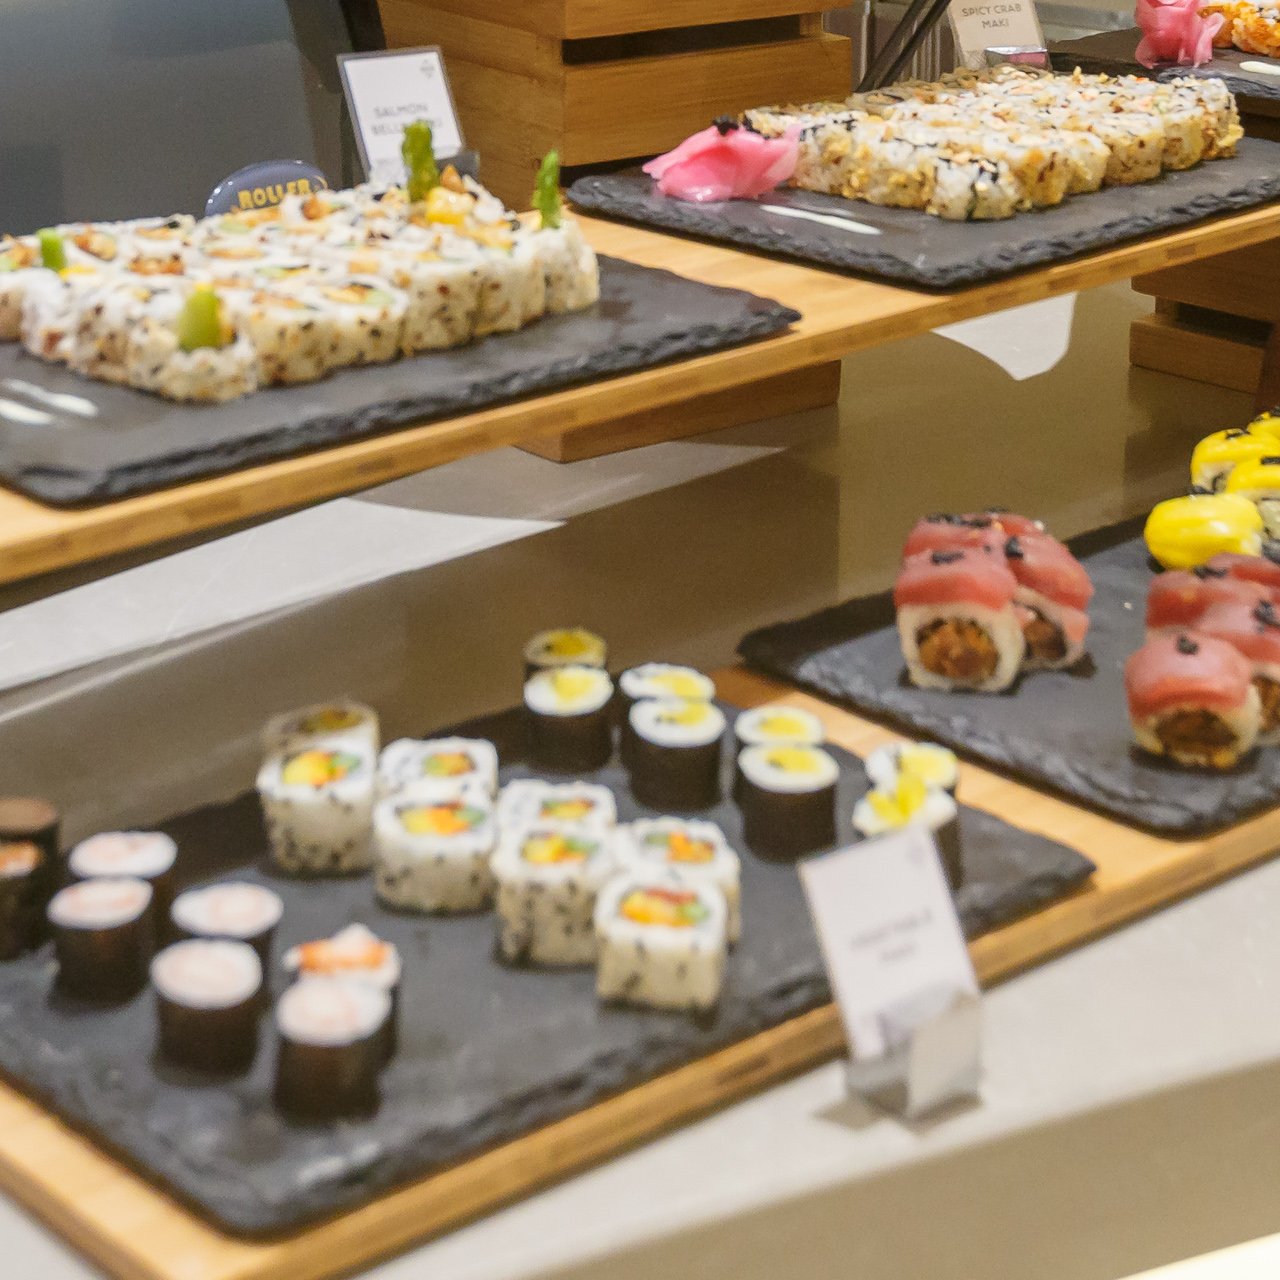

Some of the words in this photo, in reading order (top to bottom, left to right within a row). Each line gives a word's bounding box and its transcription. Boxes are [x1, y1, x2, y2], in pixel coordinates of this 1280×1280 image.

[961, 5, 991, 17] SPICY
[993, 2, 1022, 15] CRAB
[981, 18, 1010, 29] MAKI
[373, 104, 429, 118] SALMON
[238, 178, 311, 209] ROLLER
